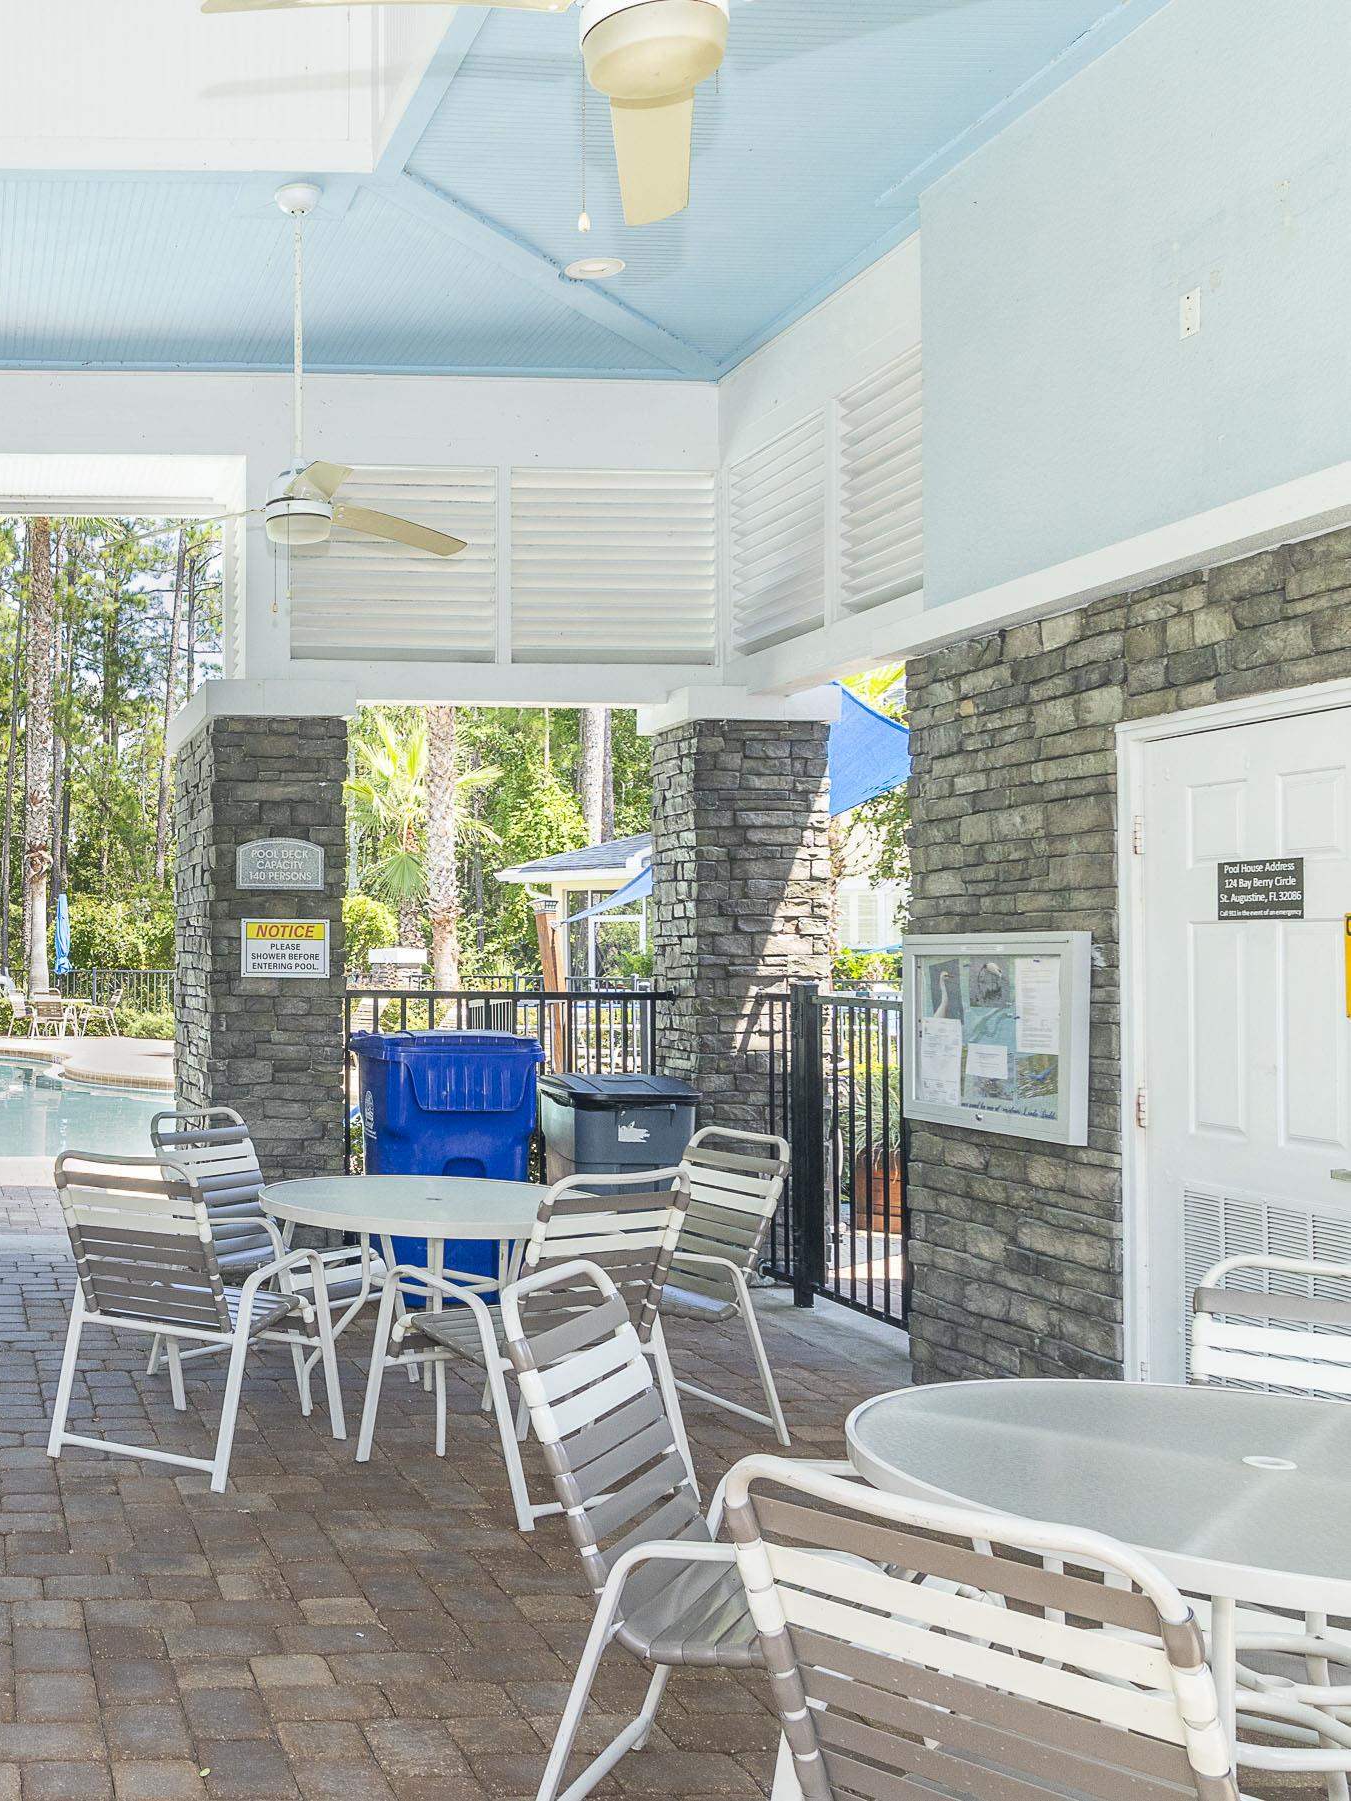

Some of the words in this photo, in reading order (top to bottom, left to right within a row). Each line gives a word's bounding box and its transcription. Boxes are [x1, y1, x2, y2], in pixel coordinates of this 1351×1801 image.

[251, 849, 278, 859] POOL
[281, 849, 309, 859] DECK
[256, 860, 303, 870] CAPACITY
[1224, 864, 1240, 874] Pool
[1240, 863, 1264, 873] House
[1264, 861, 1295, 872] Address
[249, 871, 266, 880] 140
[268, 871, 312, 880] PERSONS
[1224, 878, 1238, 889] 124
[1238, 878, 1252, 889] Bay
[1252, 877, 1274, 888] Berry
[1274, 875, 1297, 886] Circle
[1219, 893, 1230, 903] St.
[1230, 892, 1268, 905] Augustine,
[1268, 891, 1278, 901] FL
[1278, 890, 1302, 901] 32086
[256, 924, 315, 938] NOTICE
[270, 943, 301, 951] PLEASE
[251, 952, 286, 961] SHOWER
[288, 953, 320, 961] BEFORE
[252, 962, 292, 970] ENTERING
[294, 962, 319, 970] POOL.
